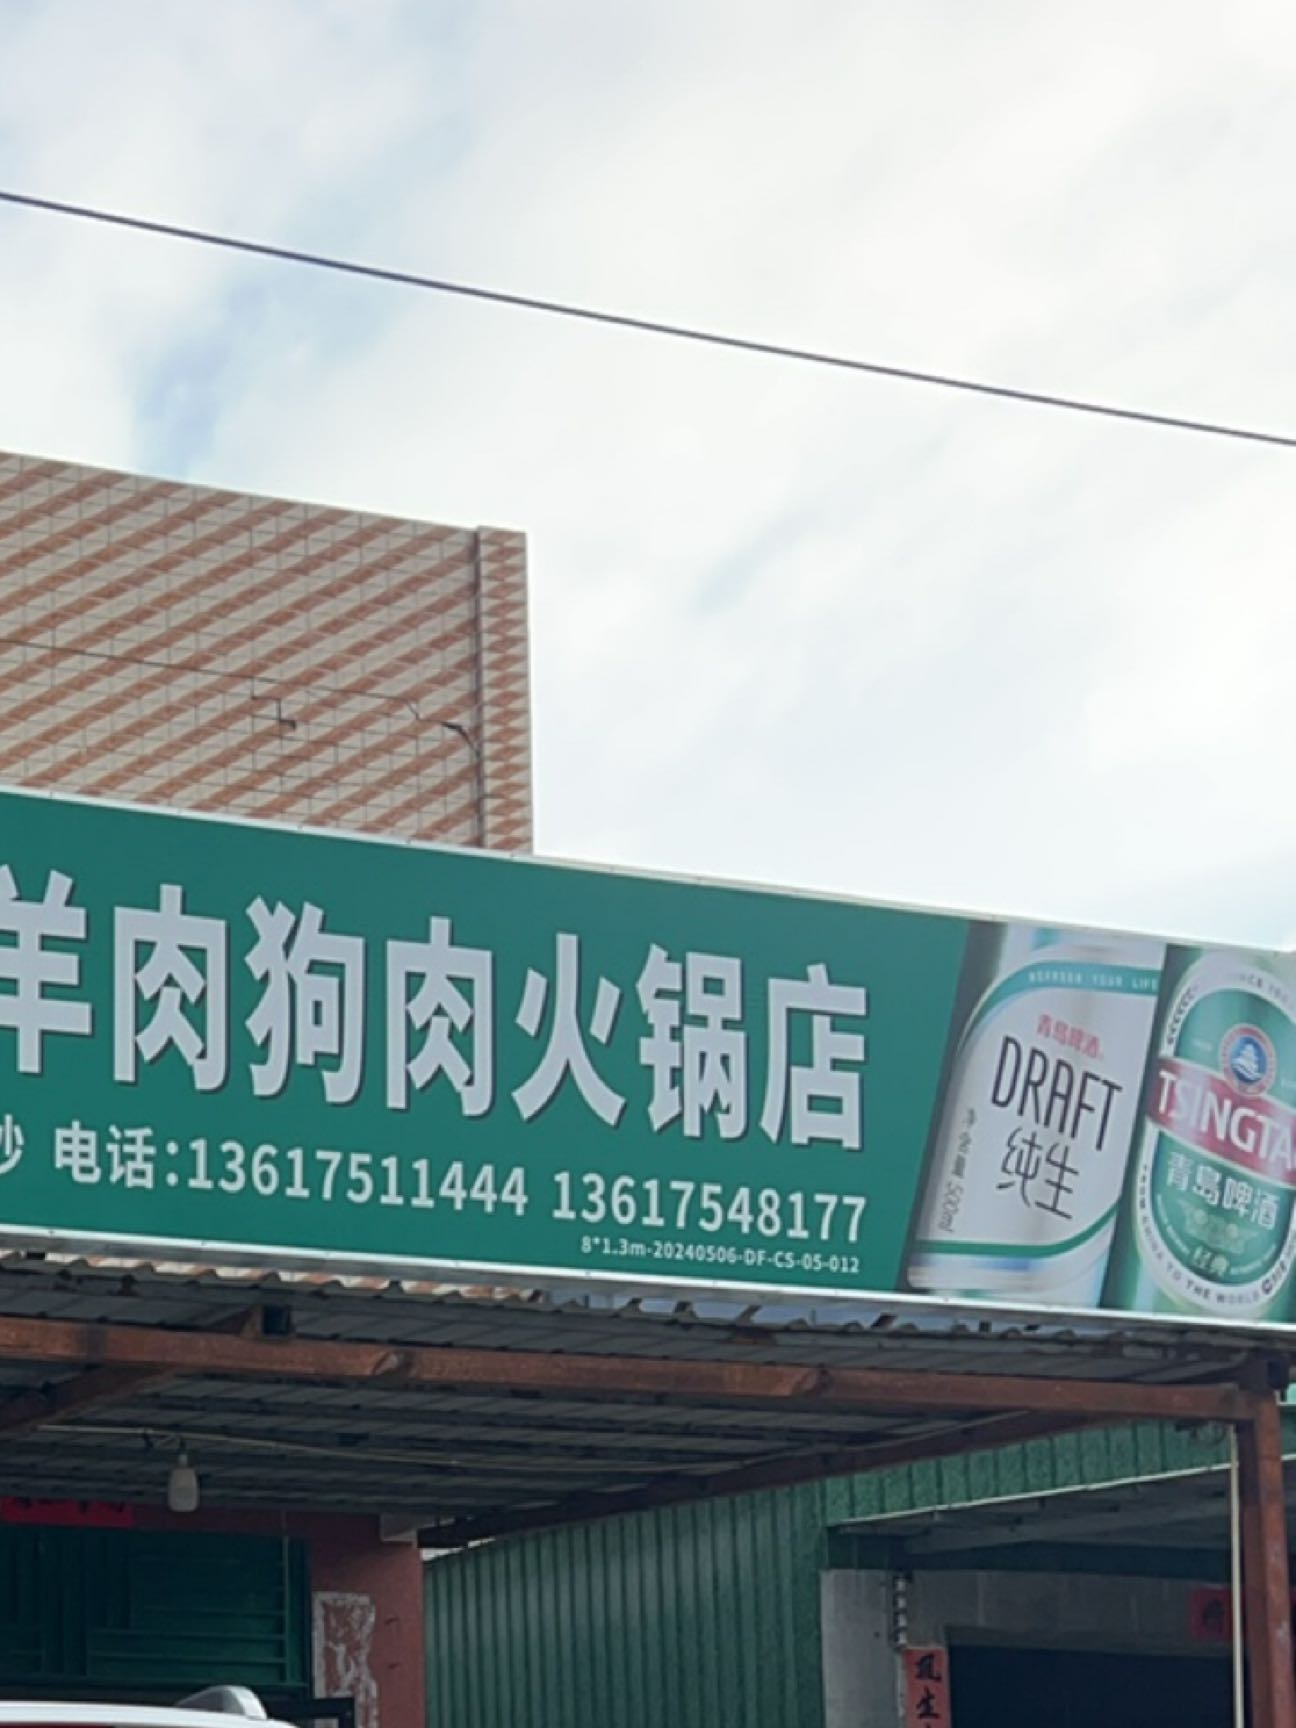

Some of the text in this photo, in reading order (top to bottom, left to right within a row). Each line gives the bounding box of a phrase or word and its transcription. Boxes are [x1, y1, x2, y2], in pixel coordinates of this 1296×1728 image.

[992, 1036, 1123, 1151] DRAFT
[1159, 1070, 1296, 1169] TSINGTA
[552, 1170, 867, 1244] 13617548177
[997, 1127, 1080, 1220] 纯生
